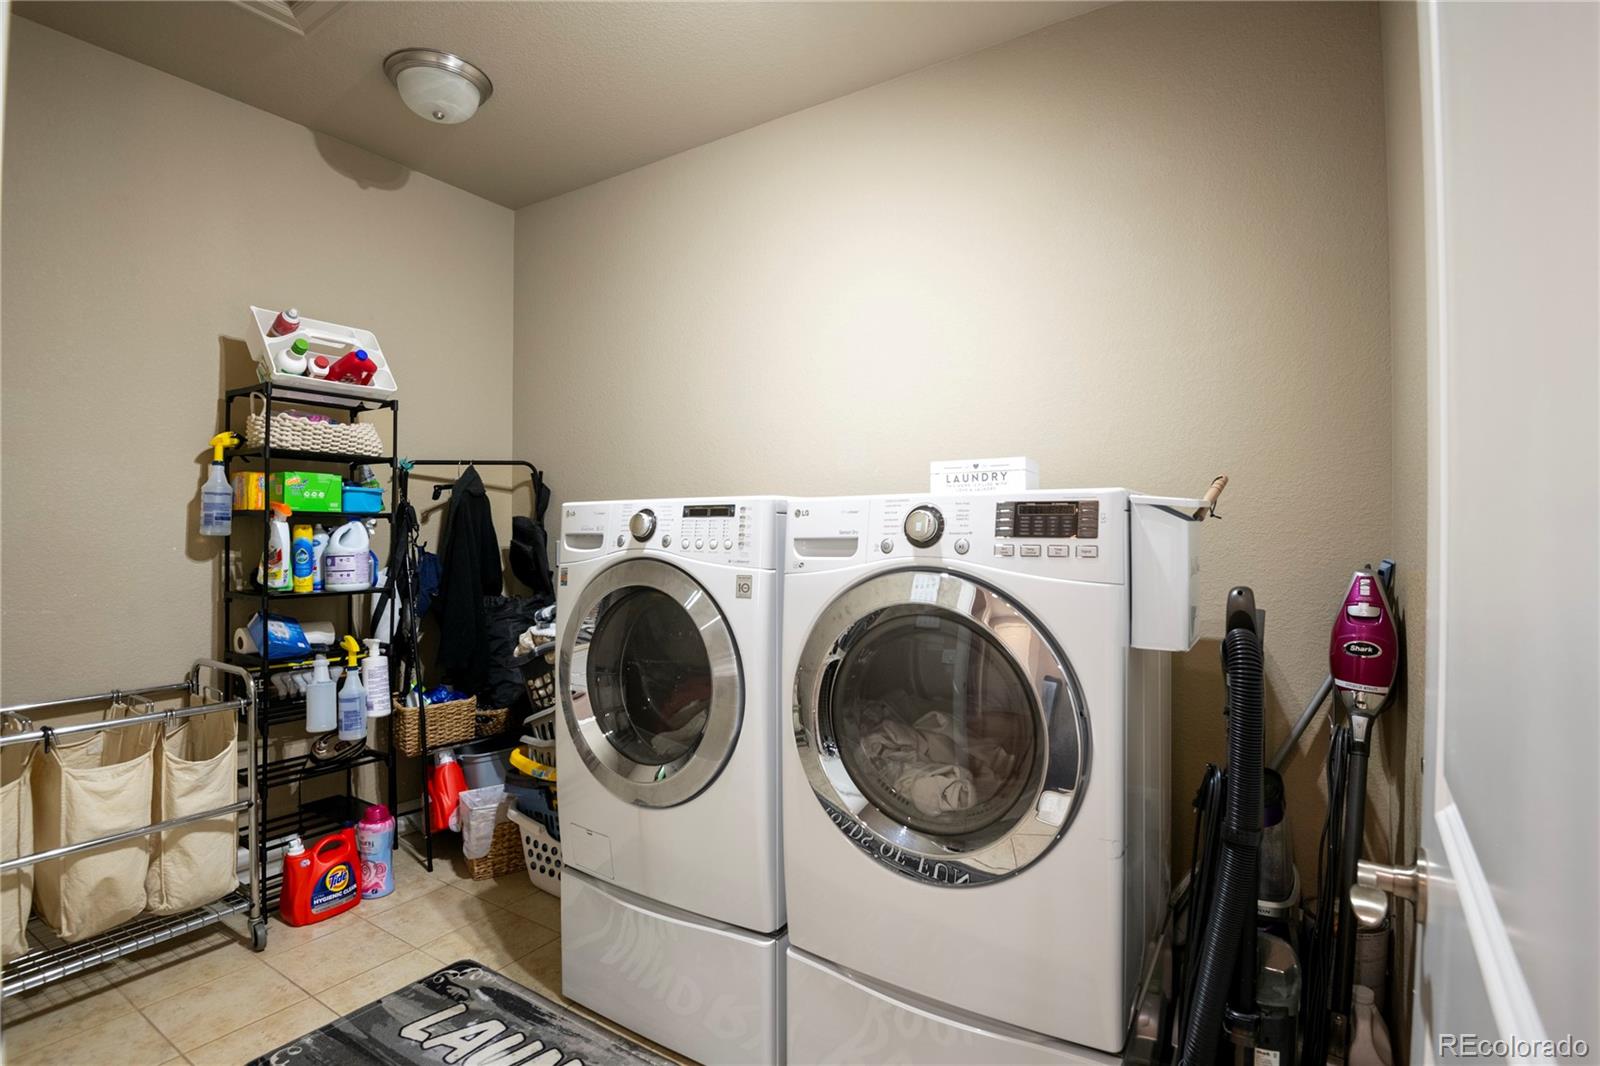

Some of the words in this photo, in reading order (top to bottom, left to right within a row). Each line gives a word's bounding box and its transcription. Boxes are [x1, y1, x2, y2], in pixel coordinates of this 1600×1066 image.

[945, 472, 1007, 484] LAUNDRY
[1349, 644, 1374, 654] Shark
[329, 871, 348, 888] Tide
[313, 891, 343, 905] HYGIENIC
